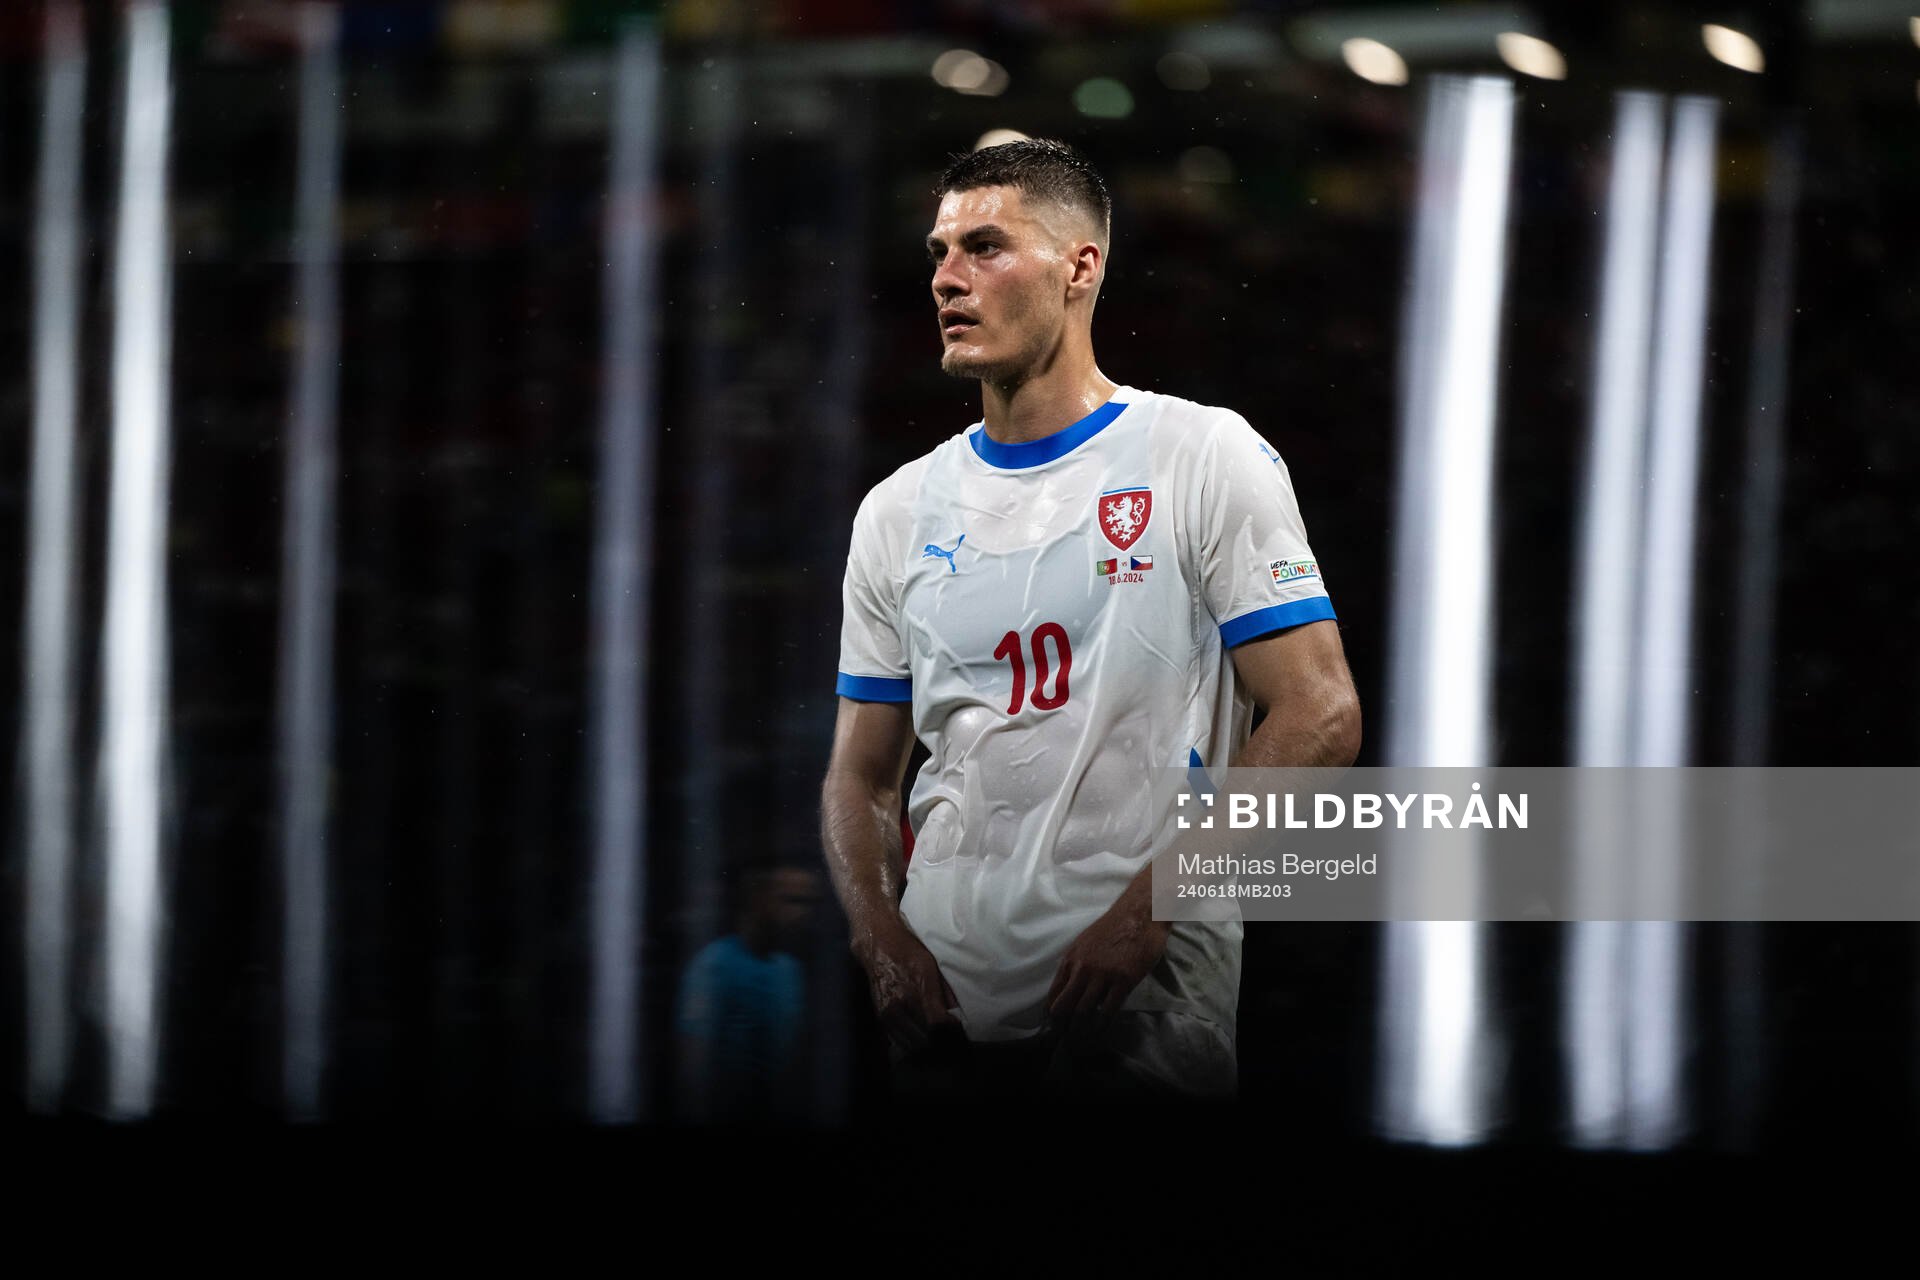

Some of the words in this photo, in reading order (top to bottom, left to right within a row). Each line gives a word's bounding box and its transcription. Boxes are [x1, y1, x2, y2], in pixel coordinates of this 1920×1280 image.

[1270, 560, 1288, 569] UEFA
[1108, 573, 1144, 585] 18.6.2024
[993, 622, 1072, 715] 10
